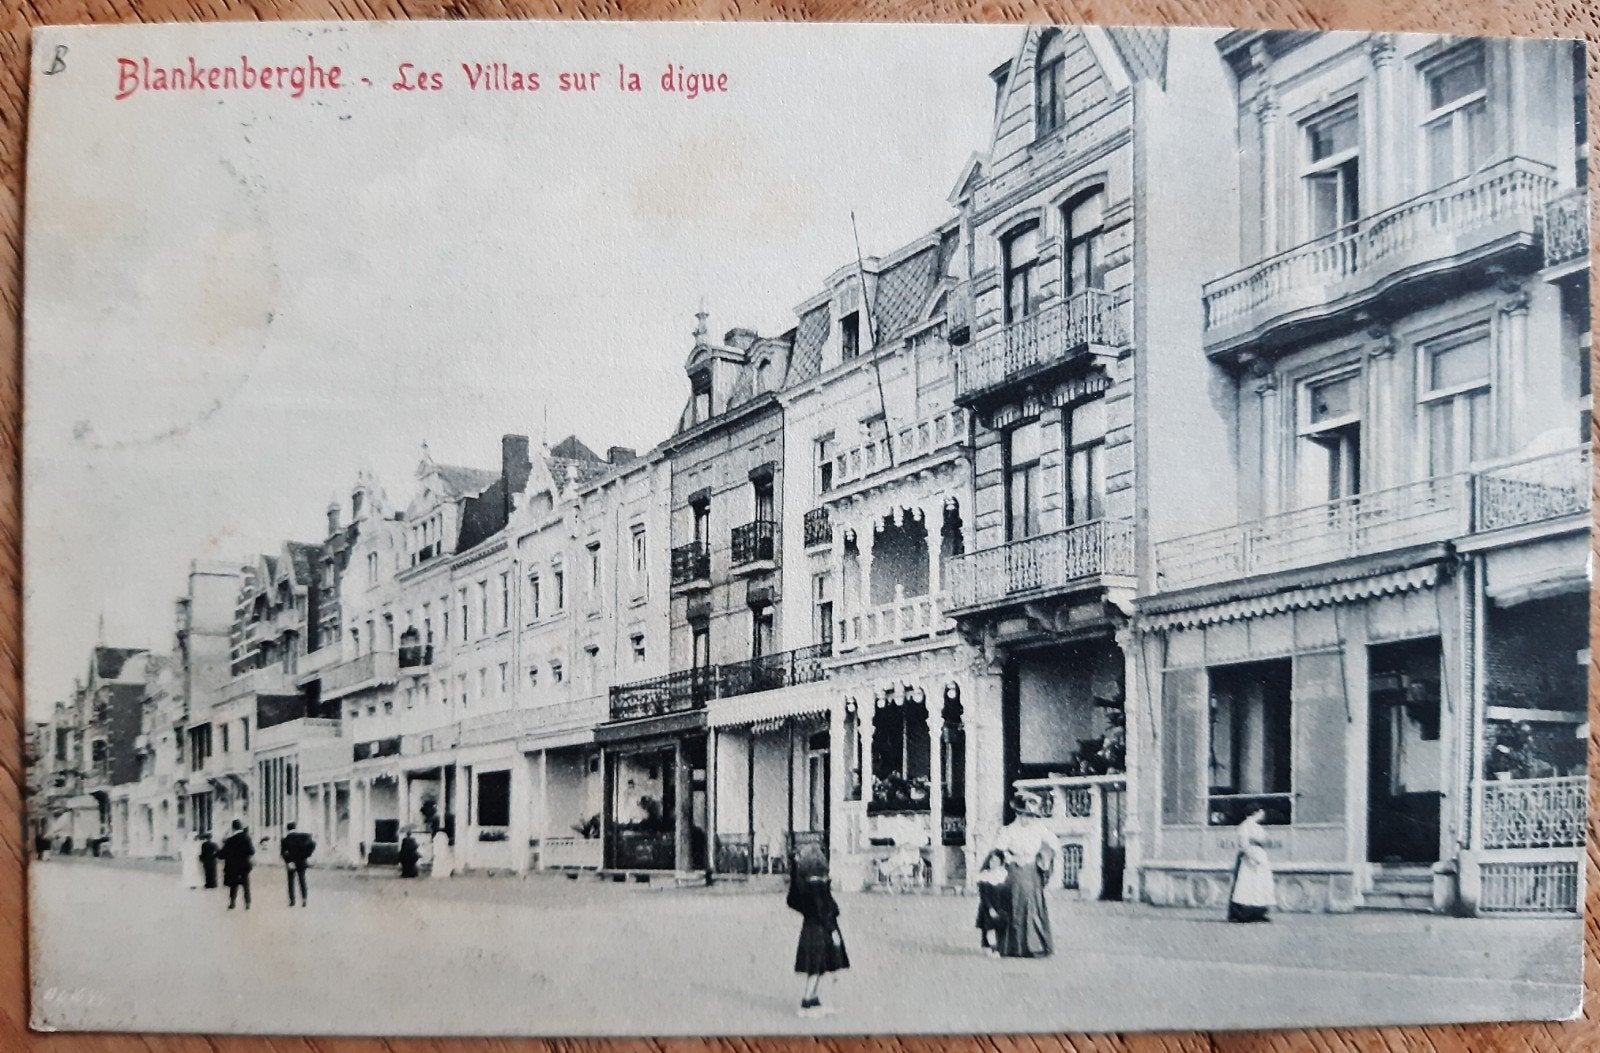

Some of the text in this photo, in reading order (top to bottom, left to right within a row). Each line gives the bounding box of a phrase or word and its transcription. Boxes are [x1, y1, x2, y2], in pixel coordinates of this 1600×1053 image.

[43, 44, 69, 75] B
[115, 55, 342, 101] Blankenberghe
[392, 63, 443, 91] Les
[461, 63, 539, 91] Villas
[559, 72, 600, 91] sur
[619, 64, 642, 91] la
[660, 65, 728, 99] digue
